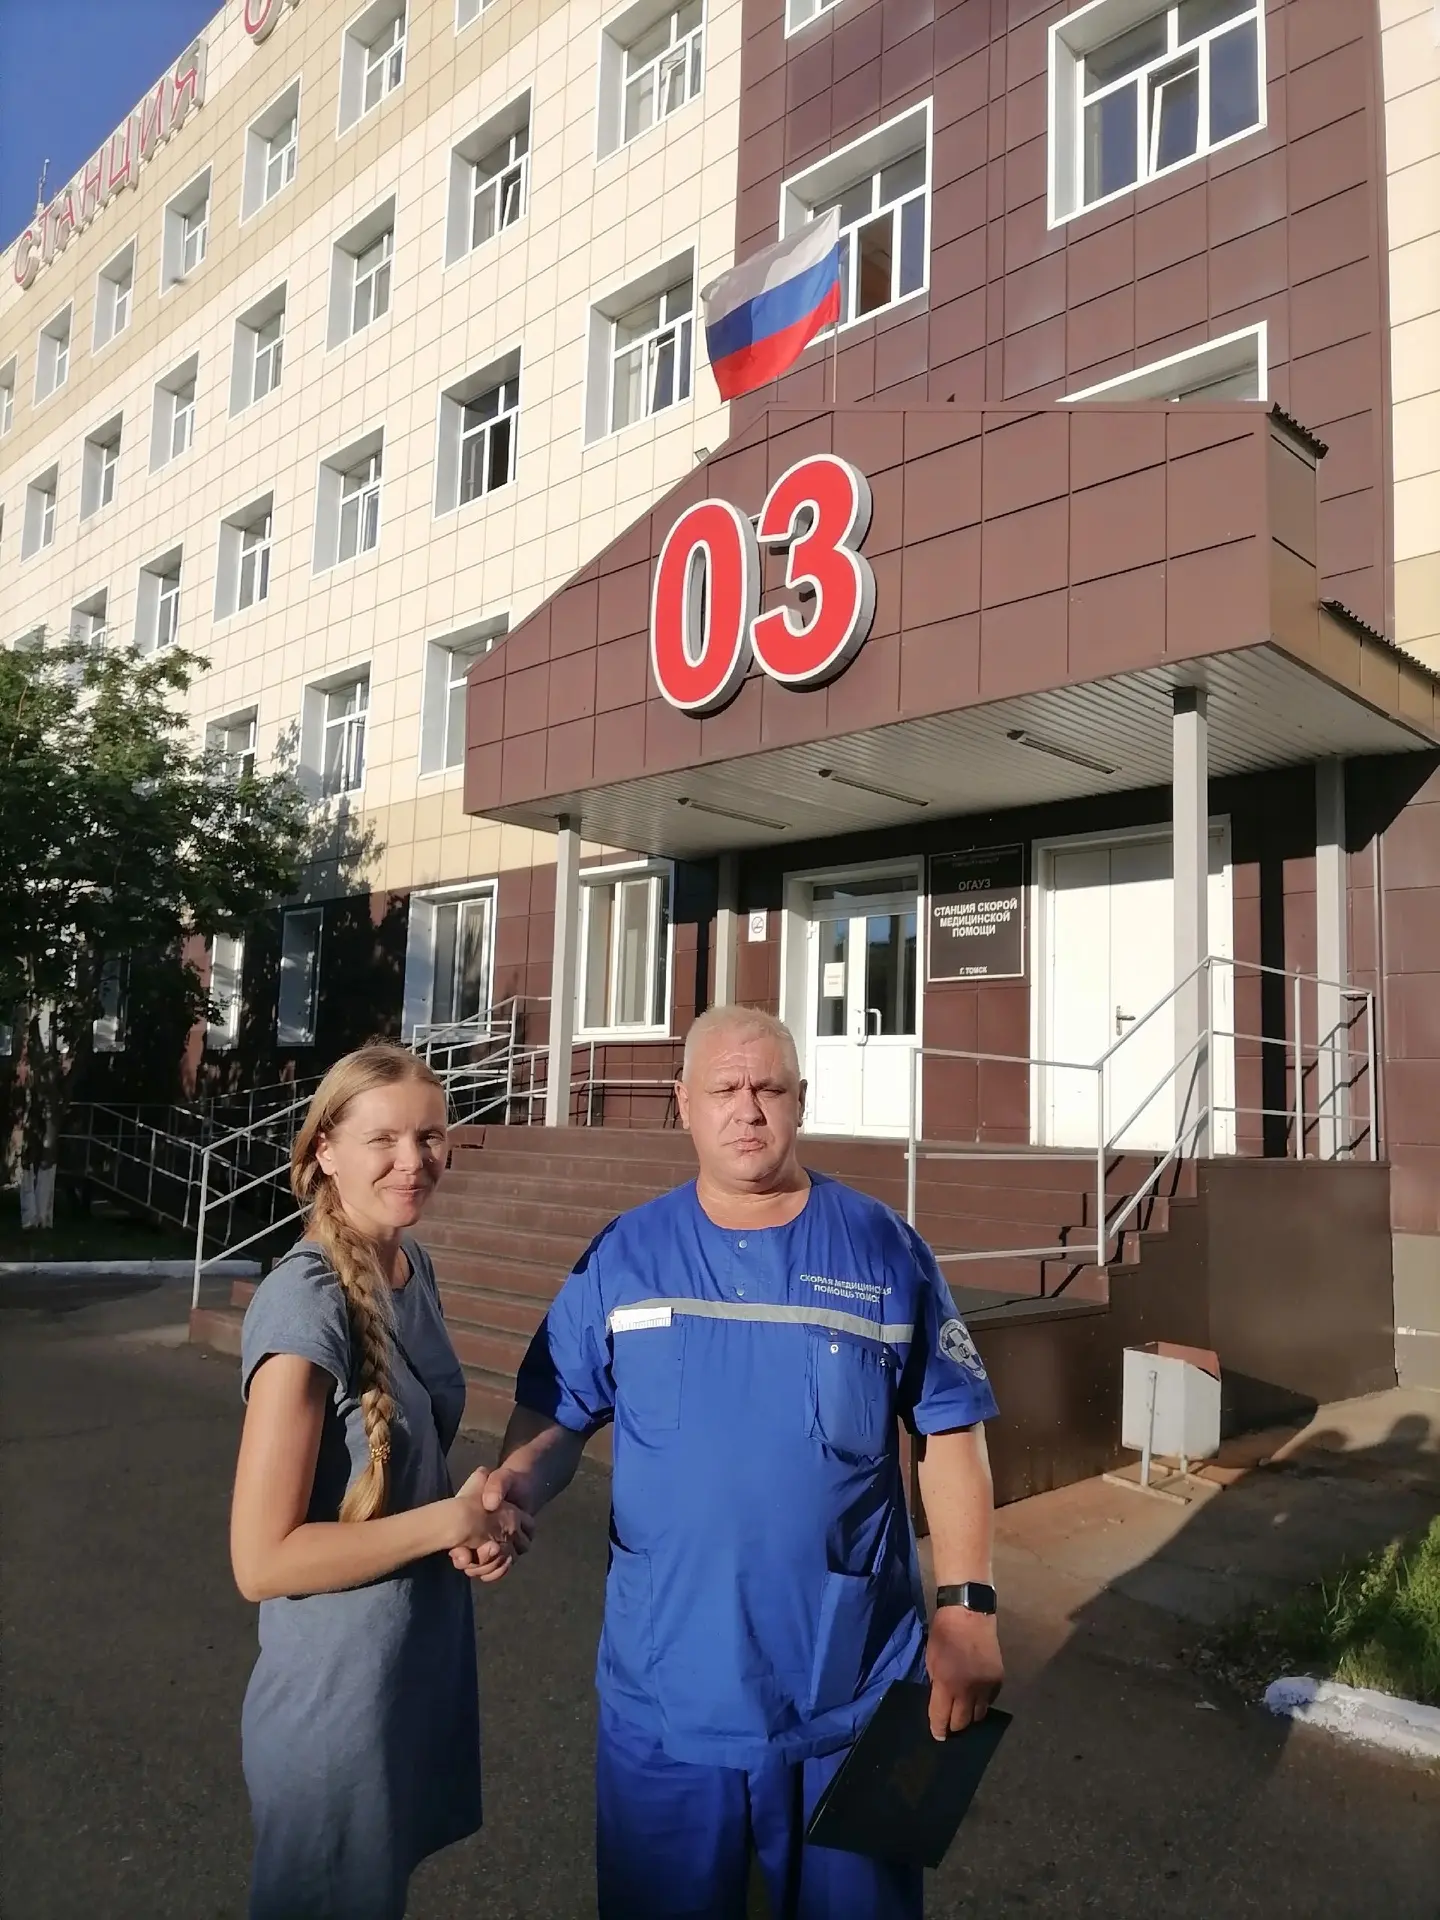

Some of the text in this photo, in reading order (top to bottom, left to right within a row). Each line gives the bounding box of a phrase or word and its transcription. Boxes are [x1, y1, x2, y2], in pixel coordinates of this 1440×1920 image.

[14, 39, 208, 289] СТАНЦИЯ
[651, 453, 876, 712] 03
[958, 878, 991, 891] ОГАУЗ
[934, 898, 1018, 917] СТАНЦИЯ СКОРОЙ
[940, 911, 1010, 927] МЕДИЦИНСКОЙ
[952, 924, 996, 938] ПОМОЩИ
[966, 966, 988, 975] ТОМСК
[799, 1273, 834, 1286] СКОРАЯ
[814, 1284, 854, 1299] ПОМОЩЬ
